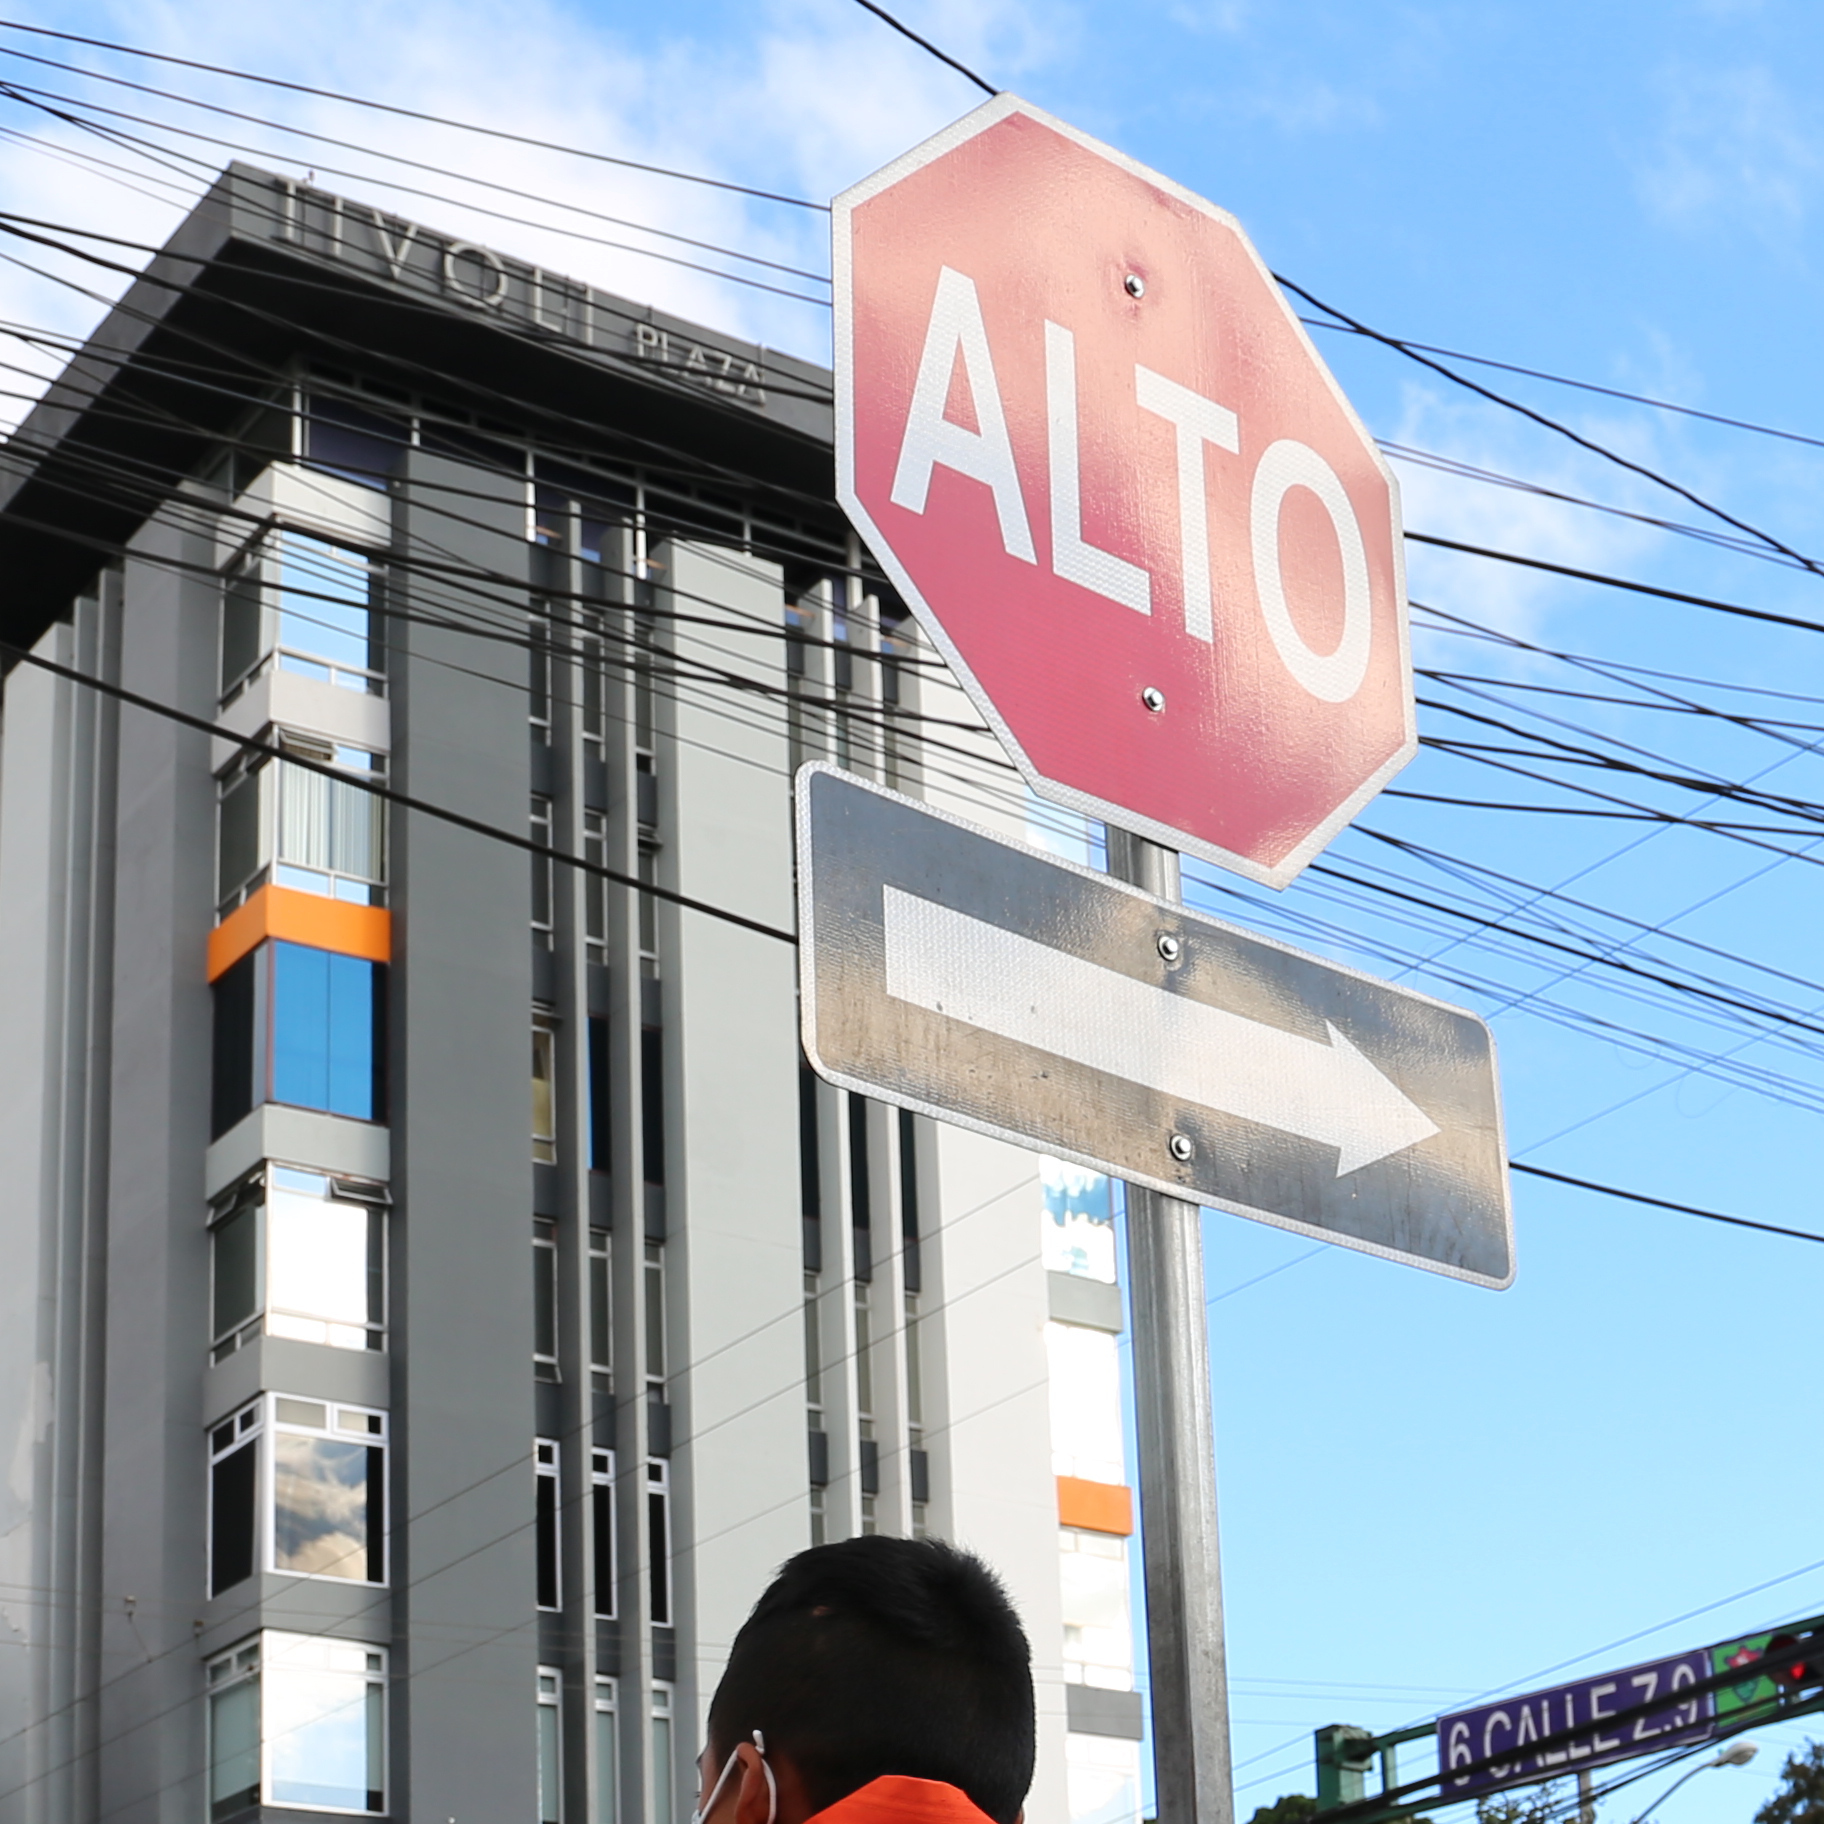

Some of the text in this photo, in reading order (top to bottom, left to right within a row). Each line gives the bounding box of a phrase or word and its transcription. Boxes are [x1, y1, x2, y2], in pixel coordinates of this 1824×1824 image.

[889, 264, 1373, 704] ALTO
[1449, 1721, 1473, 1786] 6
[1483, 1682, 1621, 1778] CALLE
